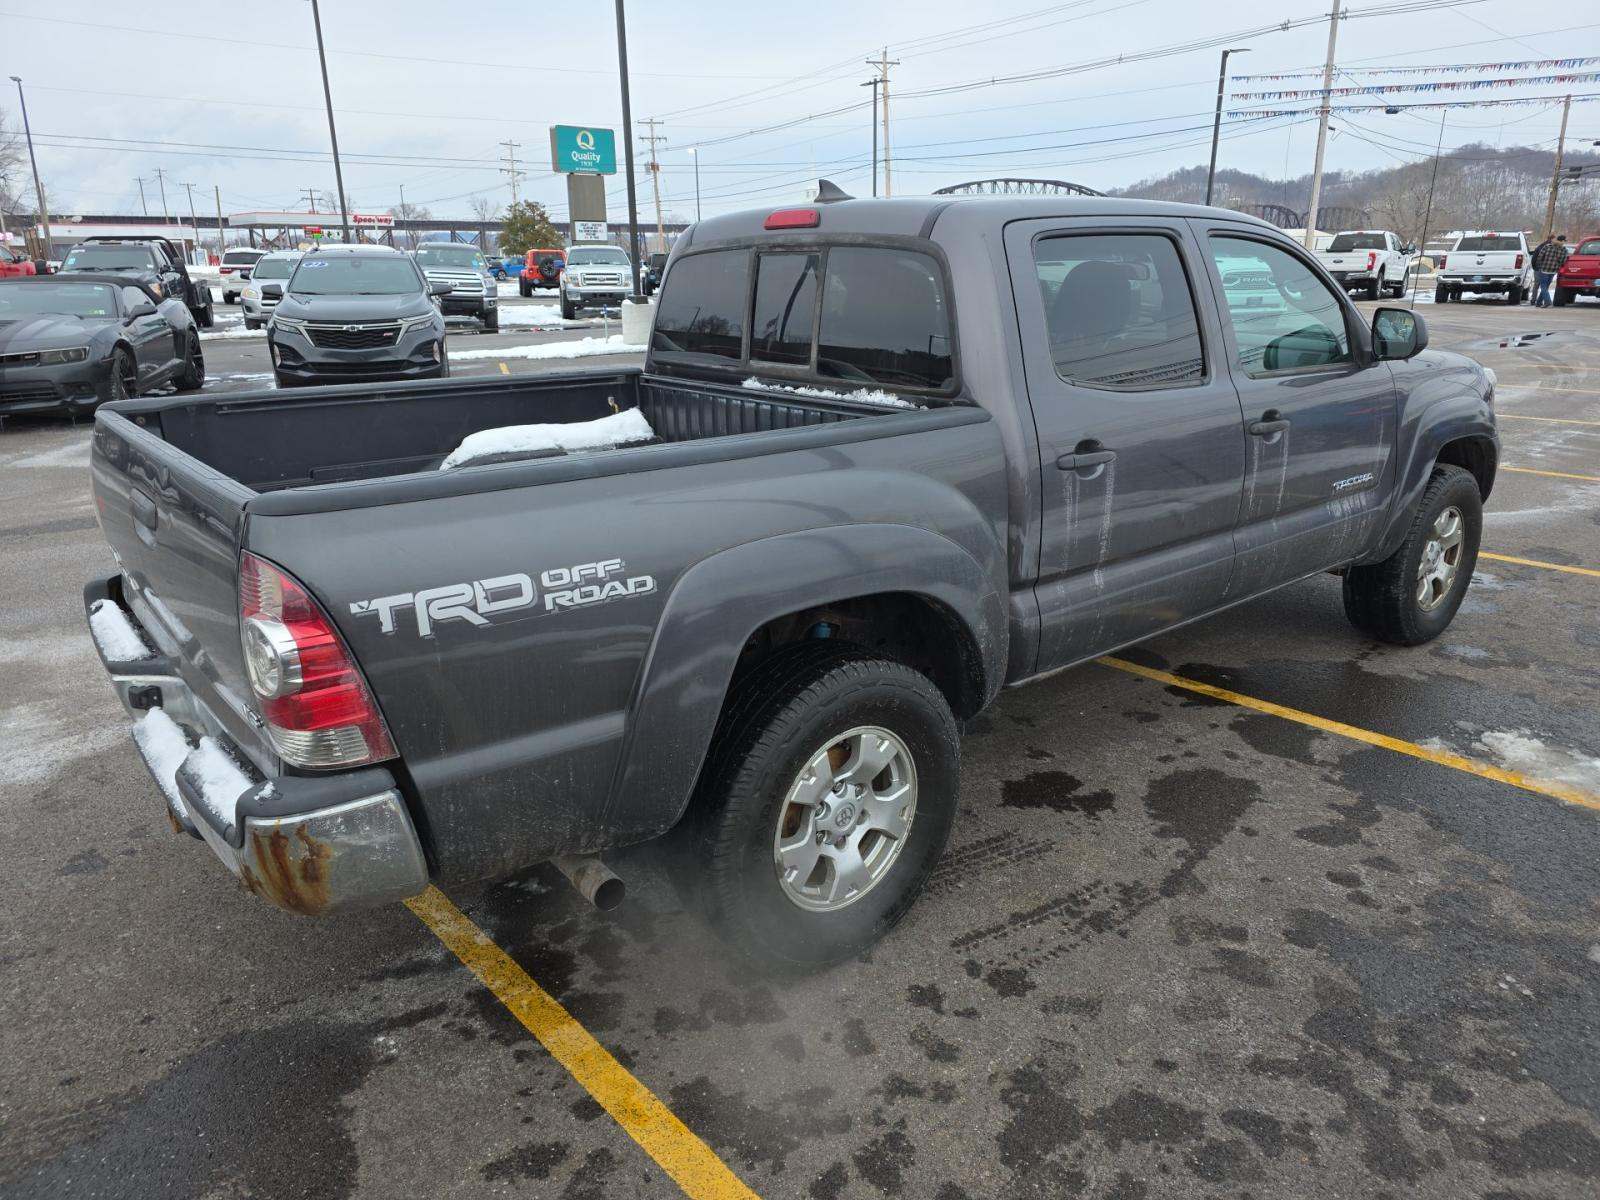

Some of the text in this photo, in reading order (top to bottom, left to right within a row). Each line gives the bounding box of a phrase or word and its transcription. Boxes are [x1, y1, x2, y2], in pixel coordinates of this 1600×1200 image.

[576, 130, 596, 150] Q
[571, 151, 601, 163] Quality
[541, 558, 622, 588] OFF
[350, 572, 536, 638] TRD
[544, 575, 655, 612] ROAD
